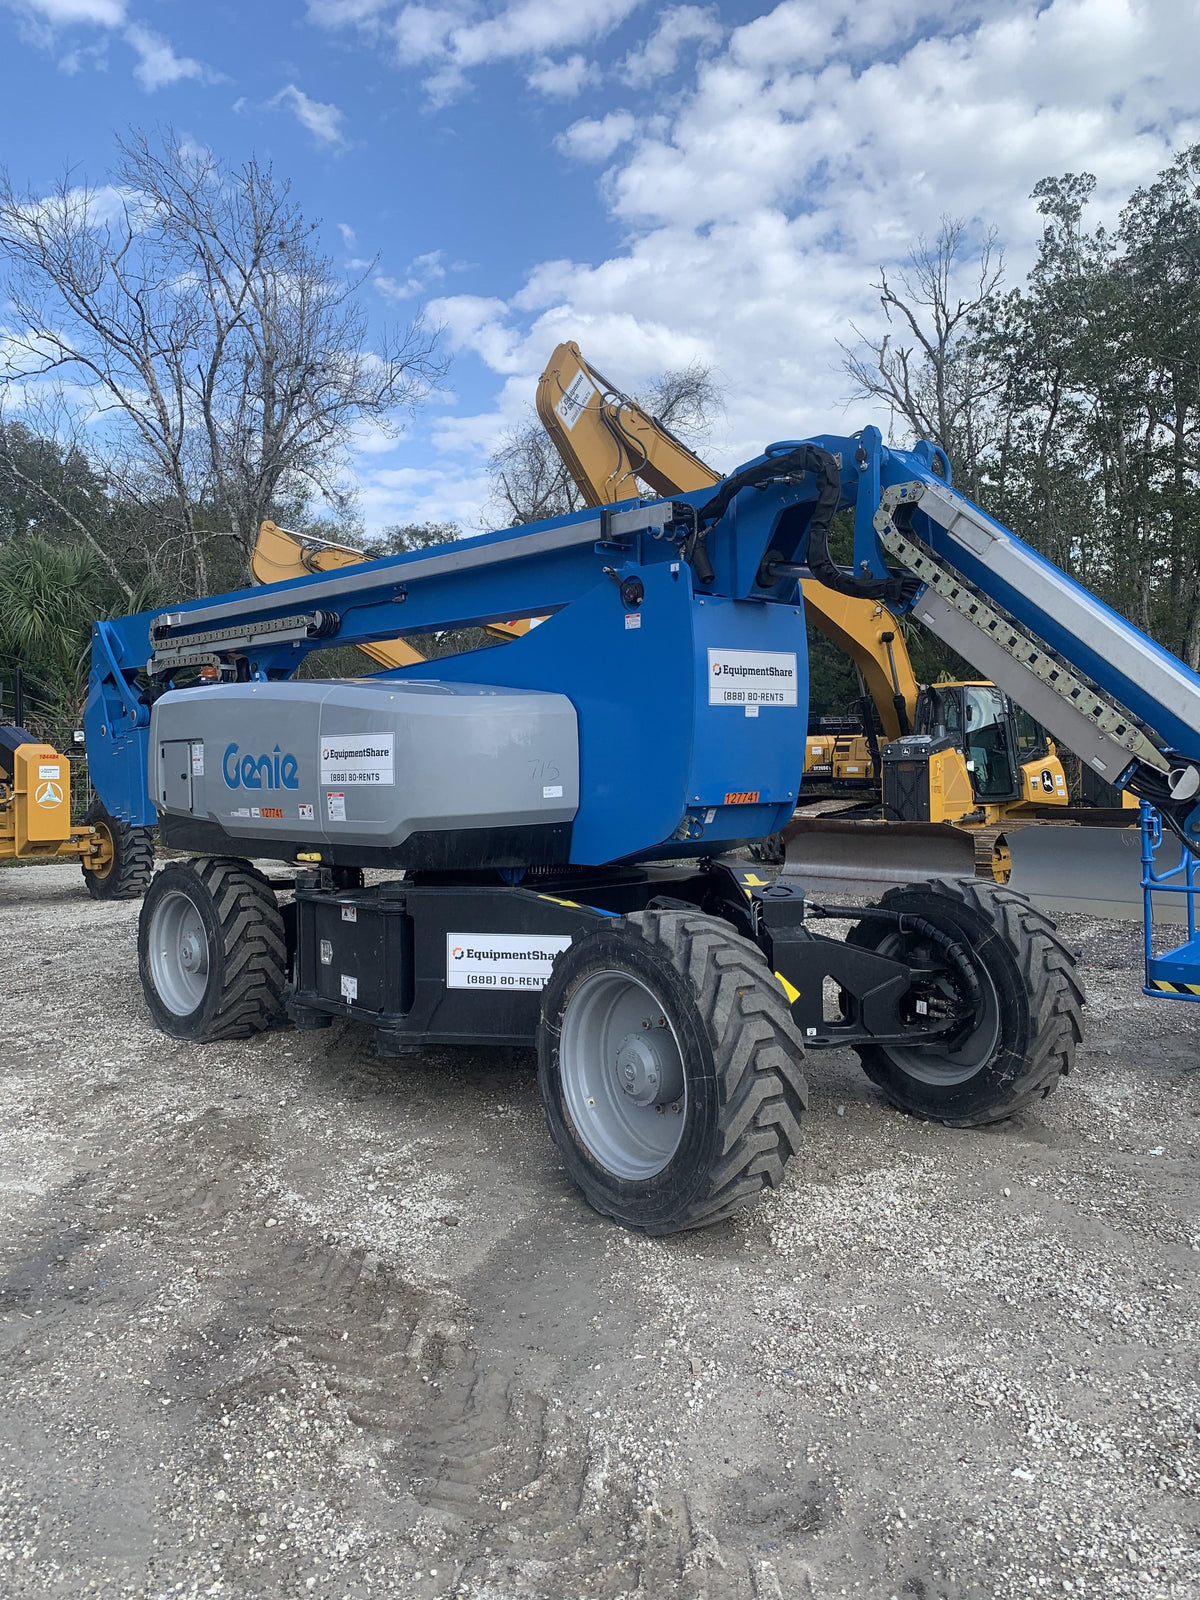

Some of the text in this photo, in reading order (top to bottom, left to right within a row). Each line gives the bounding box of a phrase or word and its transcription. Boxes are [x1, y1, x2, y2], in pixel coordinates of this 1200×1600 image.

[723, 664, 793, 677] EquipmentShare
[723, 691, 784, 701] (888) 80-RENTS
[329, 747, 390, 760] EquipmentShare
[222, 742, 299, 790] Genie
[330, 772, 380, 782] (888) 80-RENTS
[726, 792, 758, 803] 127741
[262, 808, 283, 818] 127741
[466, 948, 559, 961] EquipmentSha
[467, 974, 497, 985] (888)
